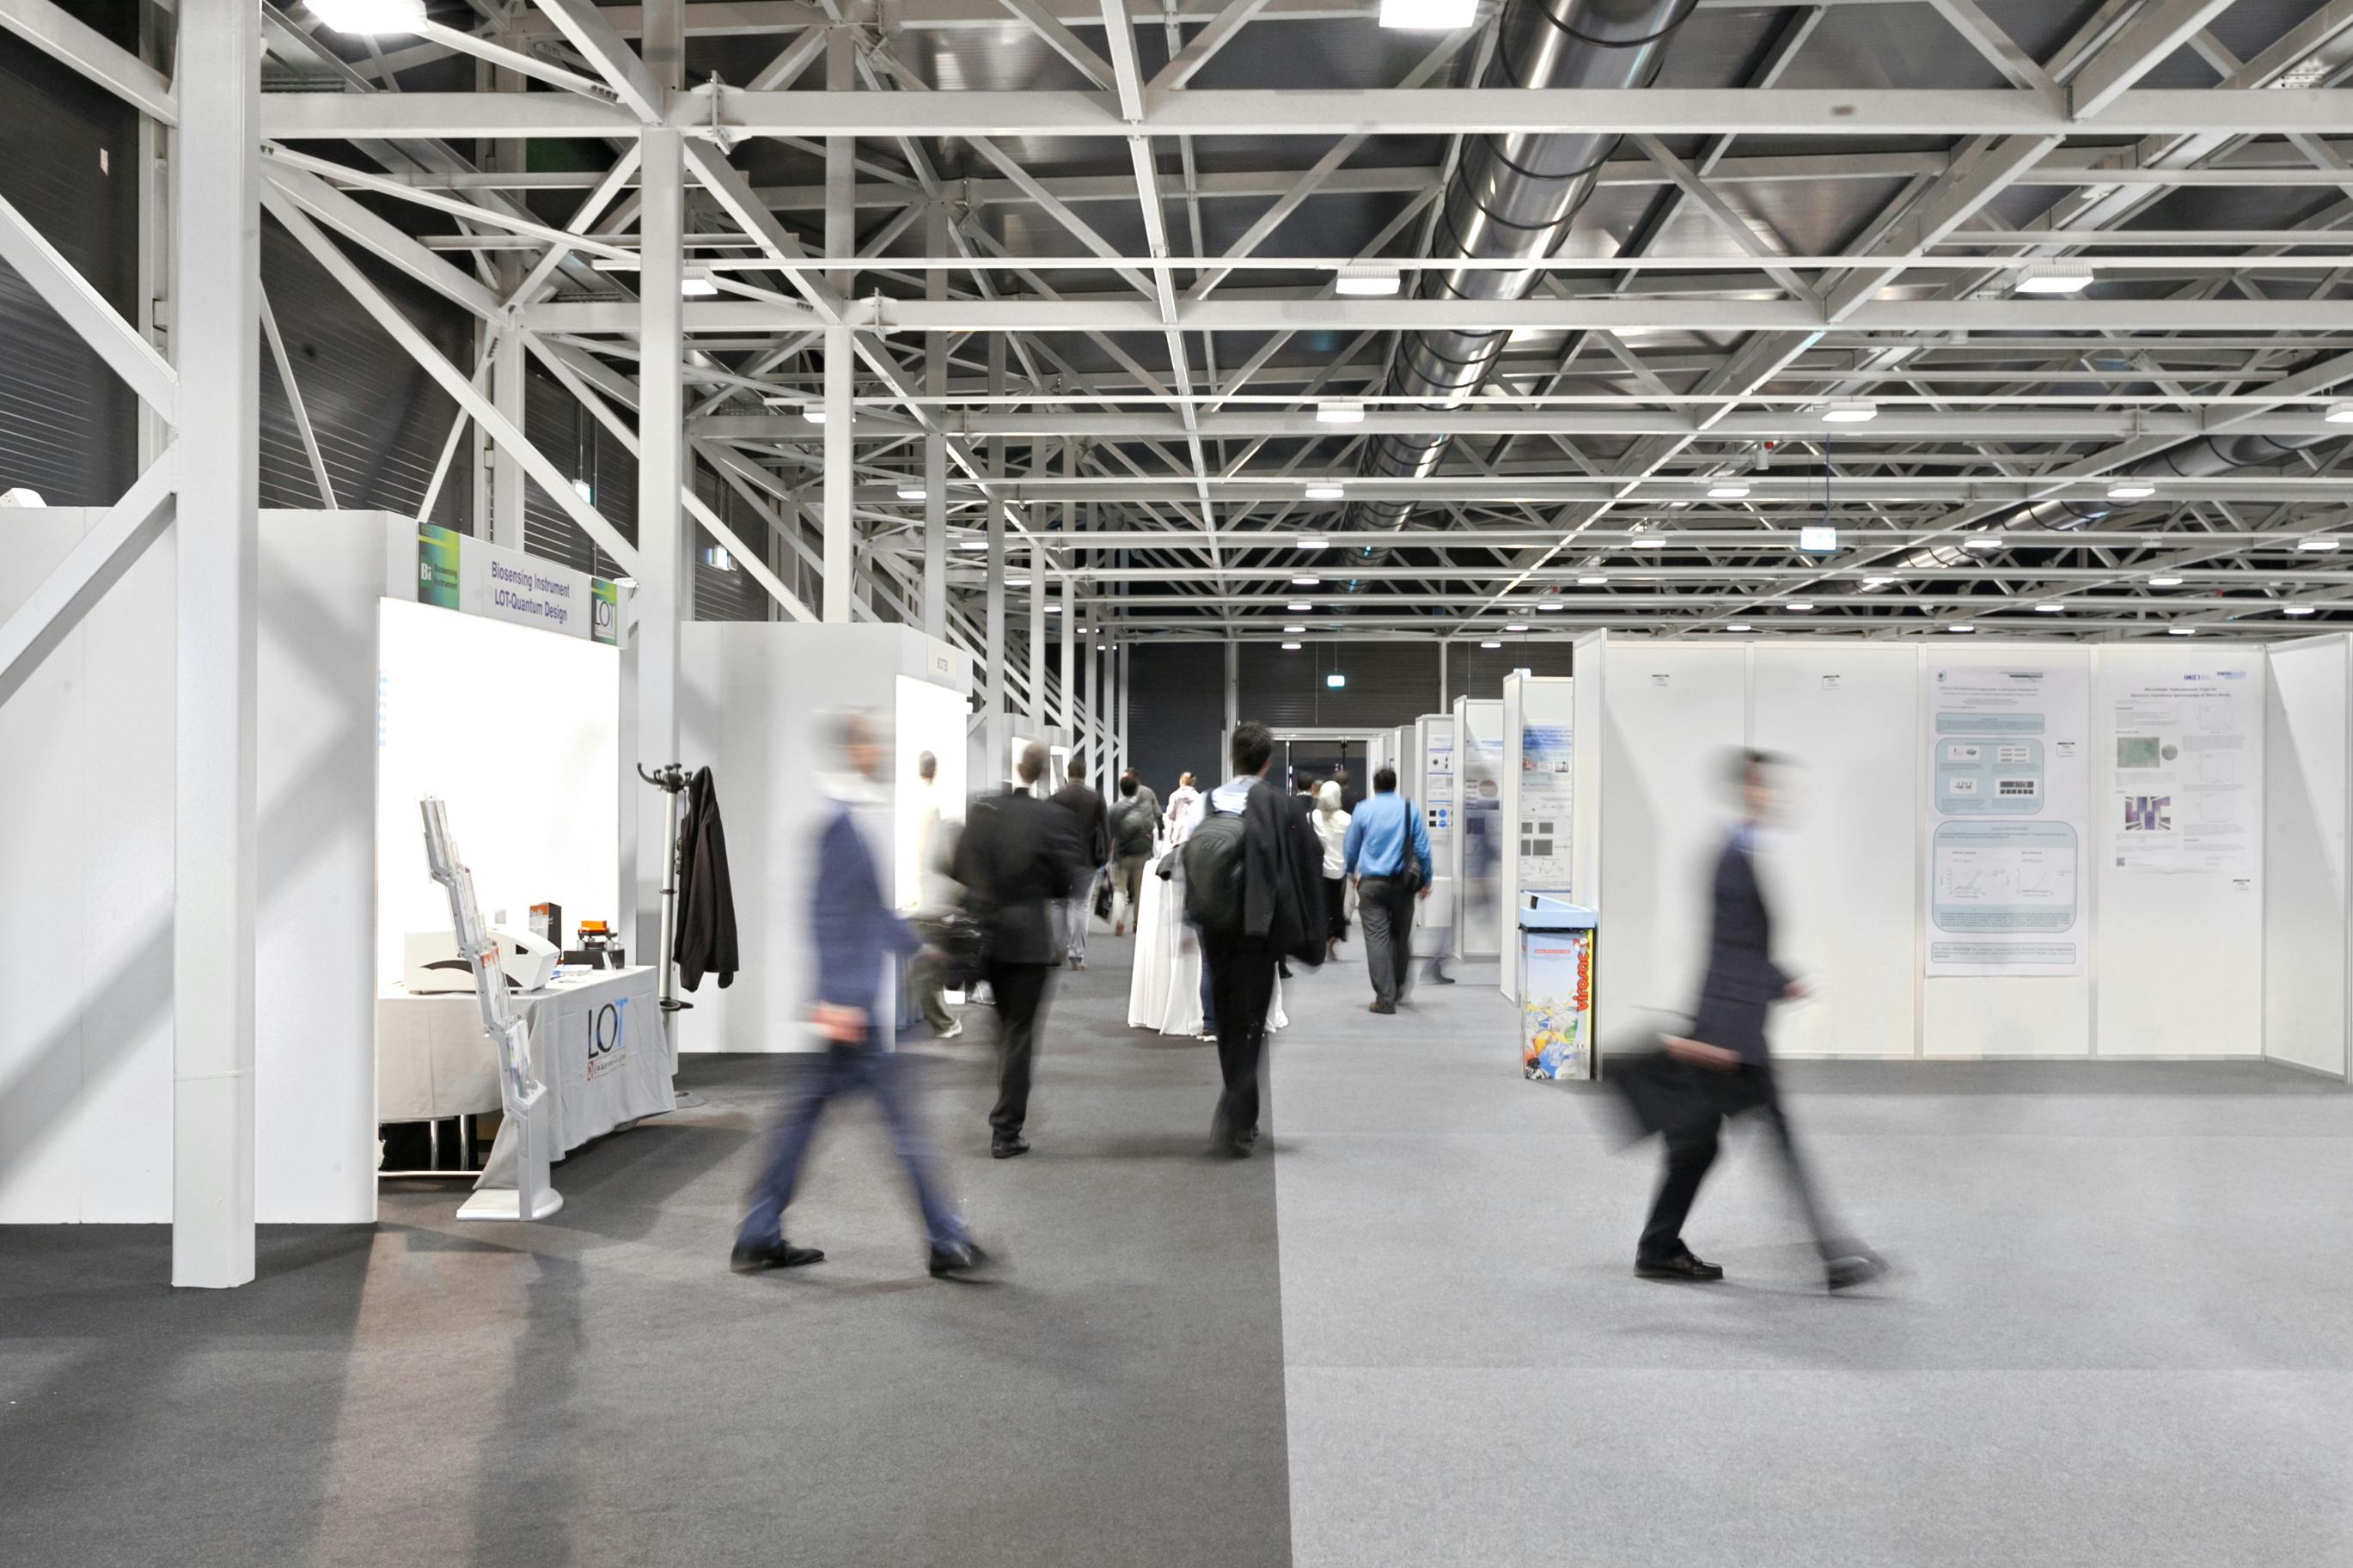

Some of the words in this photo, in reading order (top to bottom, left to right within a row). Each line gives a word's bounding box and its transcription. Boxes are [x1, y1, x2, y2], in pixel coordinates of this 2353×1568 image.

[420, 563, 431, 580] Bi
[492, 561, 533, 591] Biosensing
[535, 573, 570, 598] Instrument
[495, 588, 543, 616] LOT-Quantum
[544, 601, 568, 624] Design
[1572, 951, 1590, 1012] virosac
[588, 997, 629, 1059] LOT
